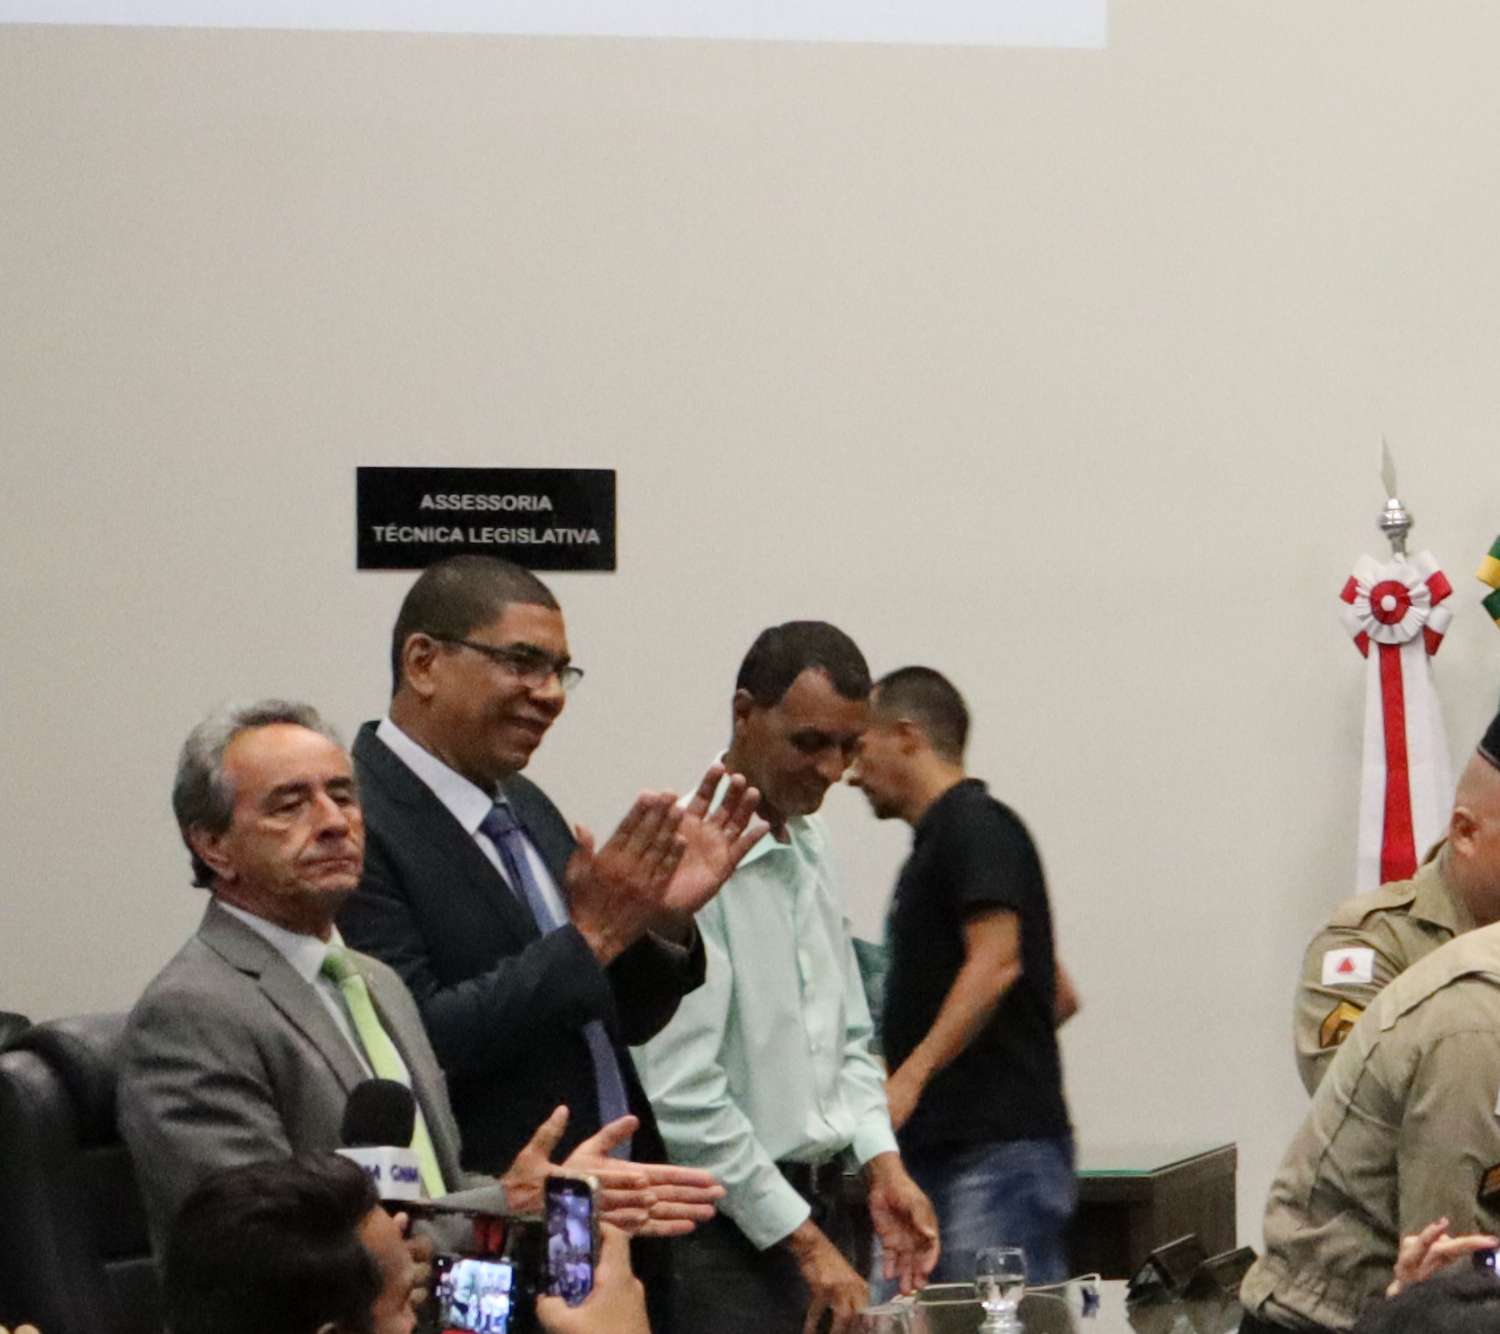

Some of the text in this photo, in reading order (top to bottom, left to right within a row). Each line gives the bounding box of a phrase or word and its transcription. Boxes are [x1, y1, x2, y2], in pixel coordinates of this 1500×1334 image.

[419, 493, 553, 511] ASSESSORIA
[372, 522, 601, 545] TÉCNICA LEGISLATIVA
